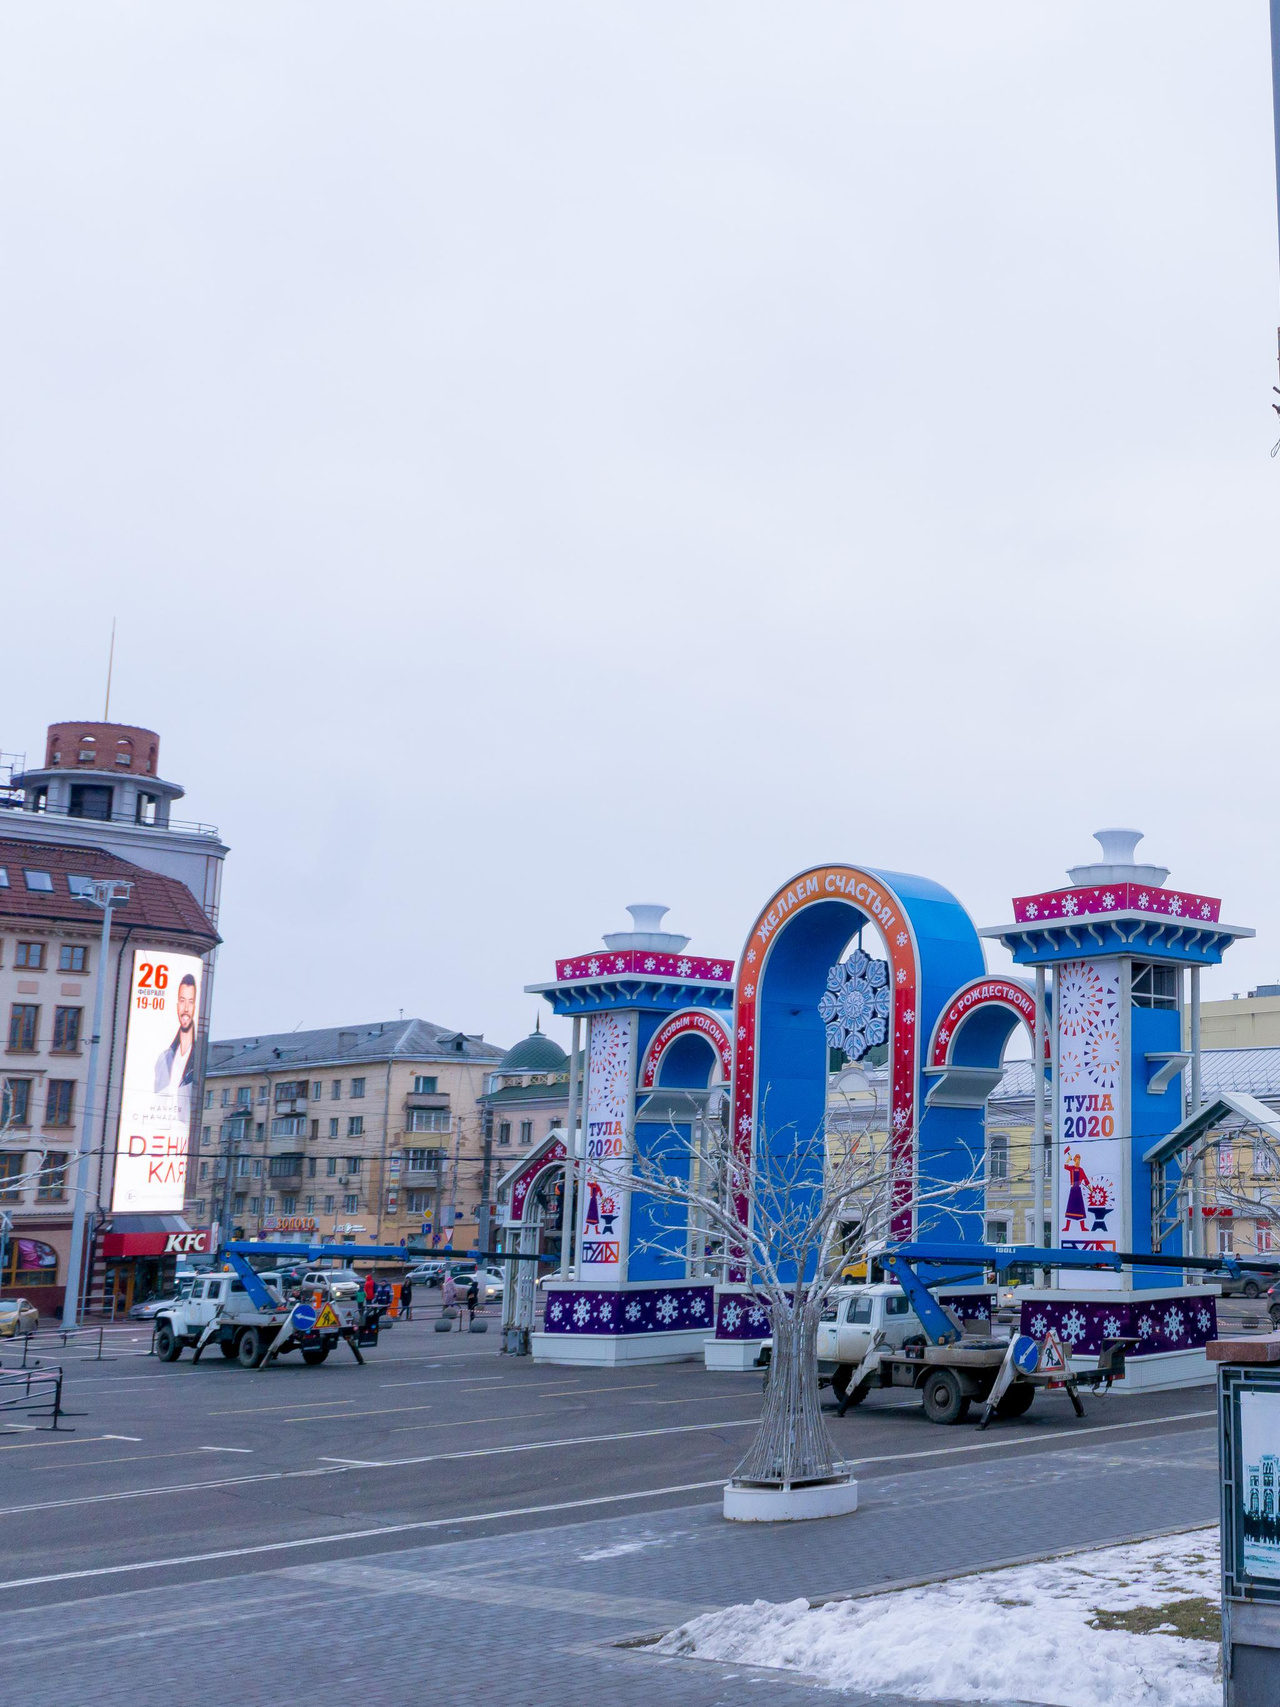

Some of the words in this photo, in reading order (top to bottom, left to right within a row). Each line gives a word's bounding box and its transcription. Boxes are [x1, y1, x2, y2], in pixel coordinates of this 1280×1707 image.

[757, 876, 820, 943] ЖЕЛАЕМ
[824, 874, 896, 930] СЧАСТЬЯ!
[138, 963, 169, 989] 26
[136, 996, 165, 1010] 19-00
[949, 1011, 958, 1020] С
[957, 985, 1033, 1014] РОЖДЕСТВОМ!
[655, 1043, 662, 1051] С
[661, 1016, 690, 1042] НОВЫМ
[693, 1016, 725, 1046] ГОДОМ!
[1064, 1094, 1115, 1113] ТУЛА
[589, 1121, 624, 1136] ТУЛА
[1064, 1115, 1115, 1138] 2020
[588, 1138, 623, 1157] 2020
[277, 1217, 315, 1229] ЗОЛОТО
[164, 1233, 207, 1253] KFC
